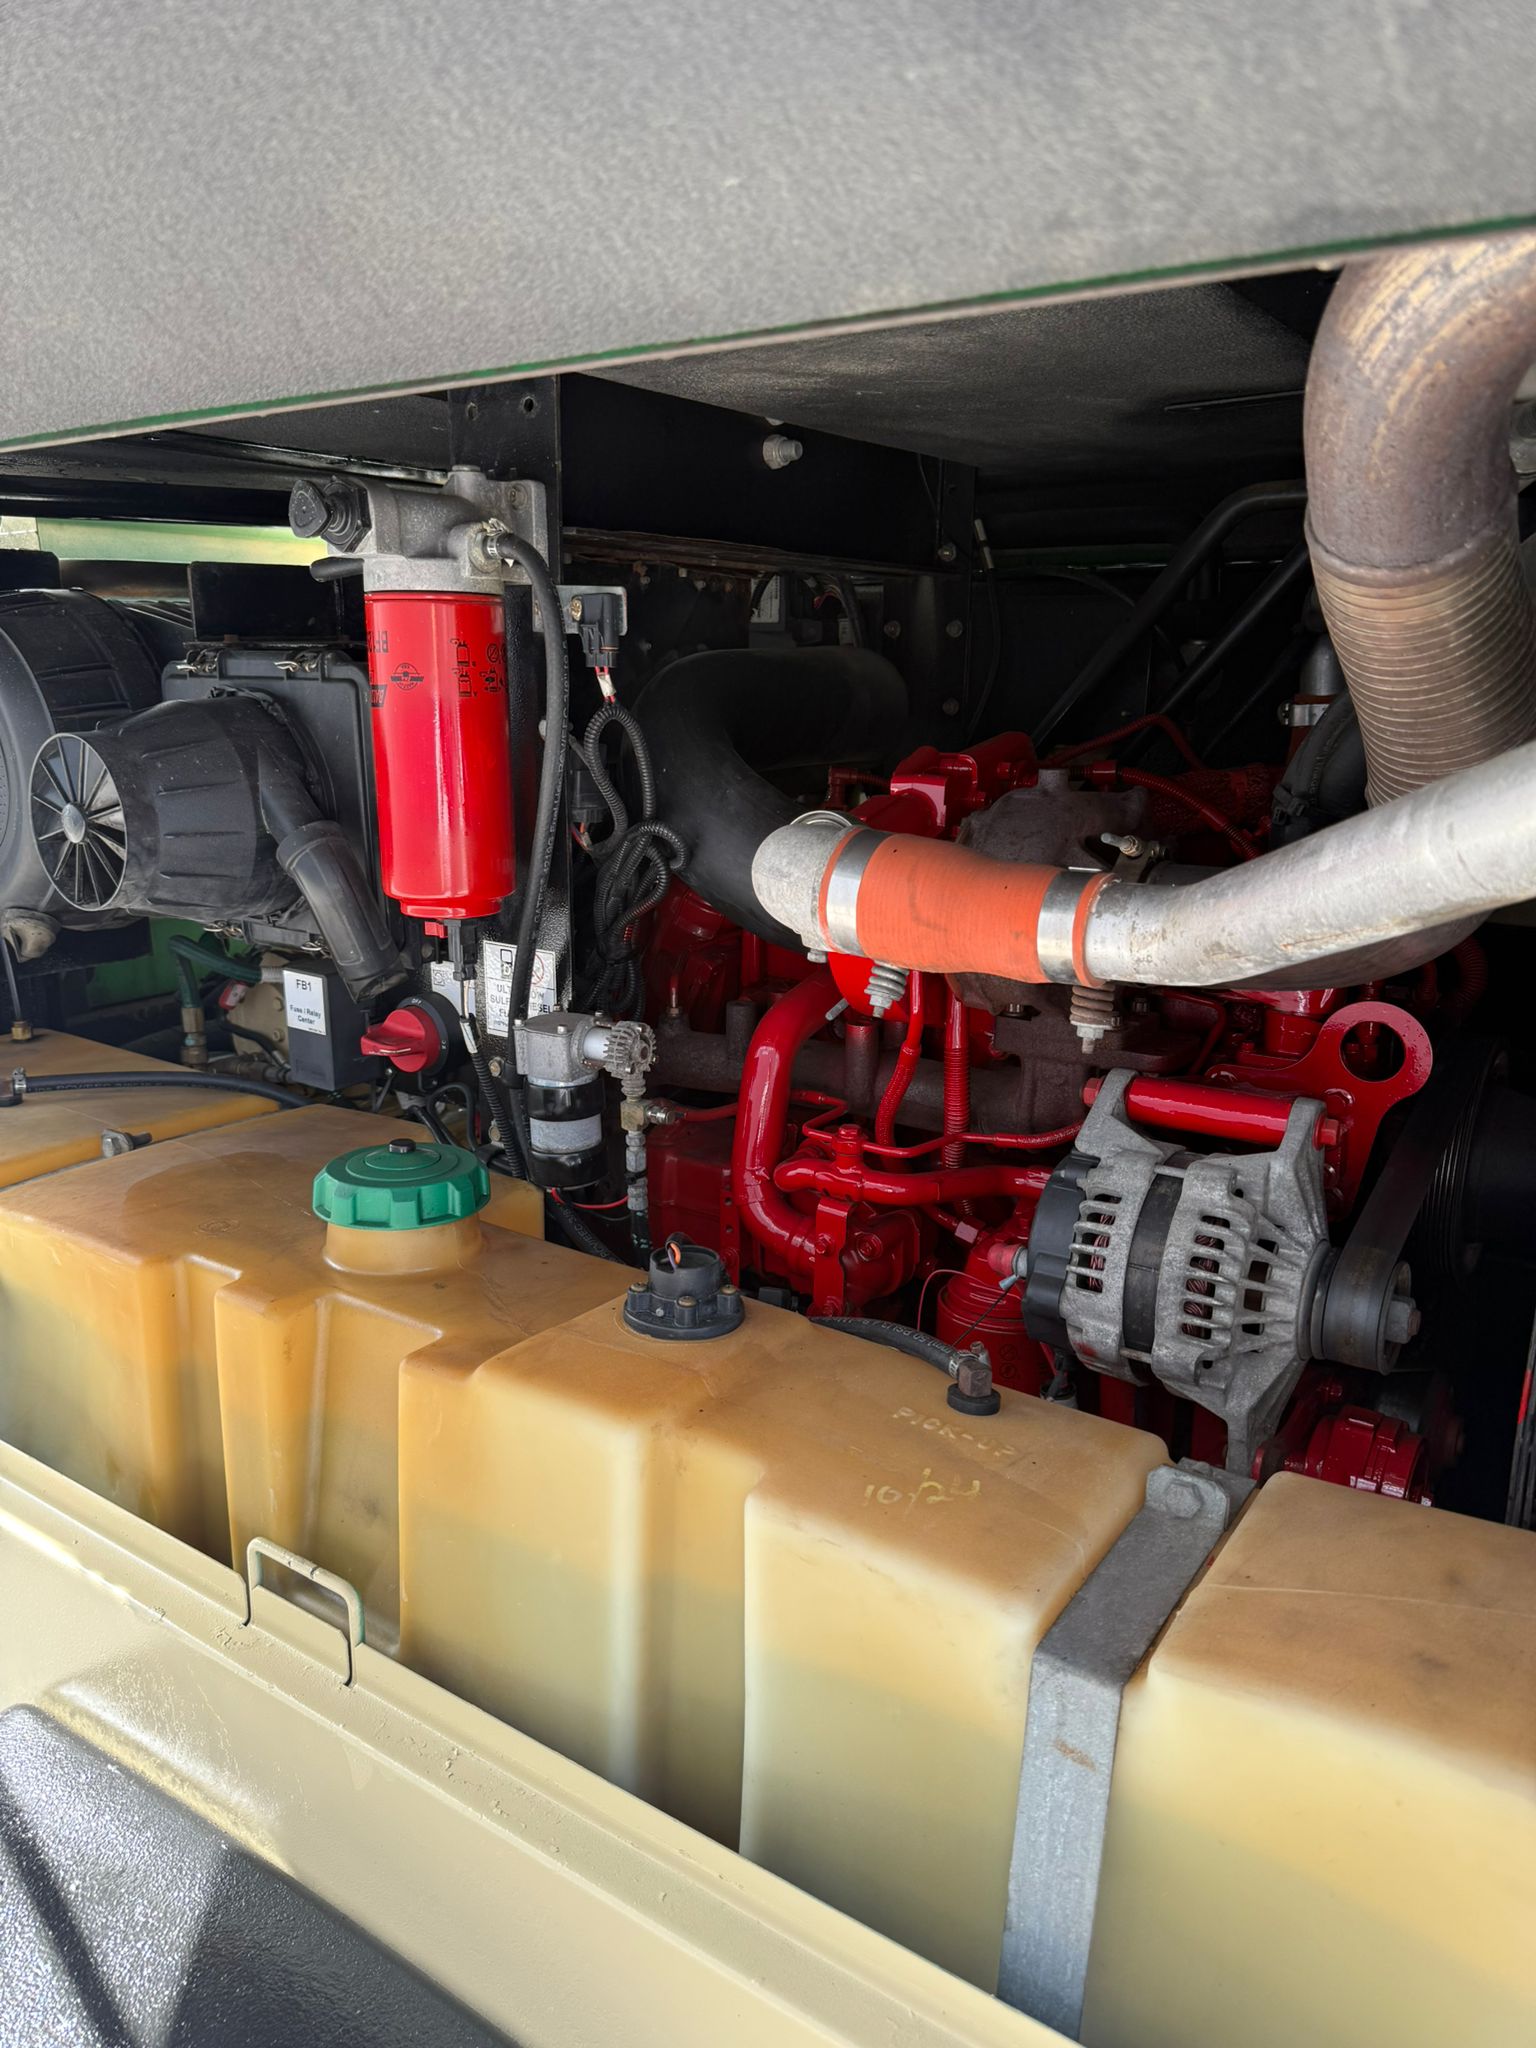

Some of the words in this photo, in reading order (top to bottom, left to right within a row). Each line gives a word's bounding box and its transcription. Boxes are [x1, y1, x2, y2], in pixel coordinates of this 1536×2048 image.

[295, 979, 312, 992] FB1
[290, 1005, 303, 1015] Fuse
[306, 1007, 321, 1019] Relay
[297, 1015, 315, 1025] Center
[891, 1406, 1017, 1457] PICK-UP
